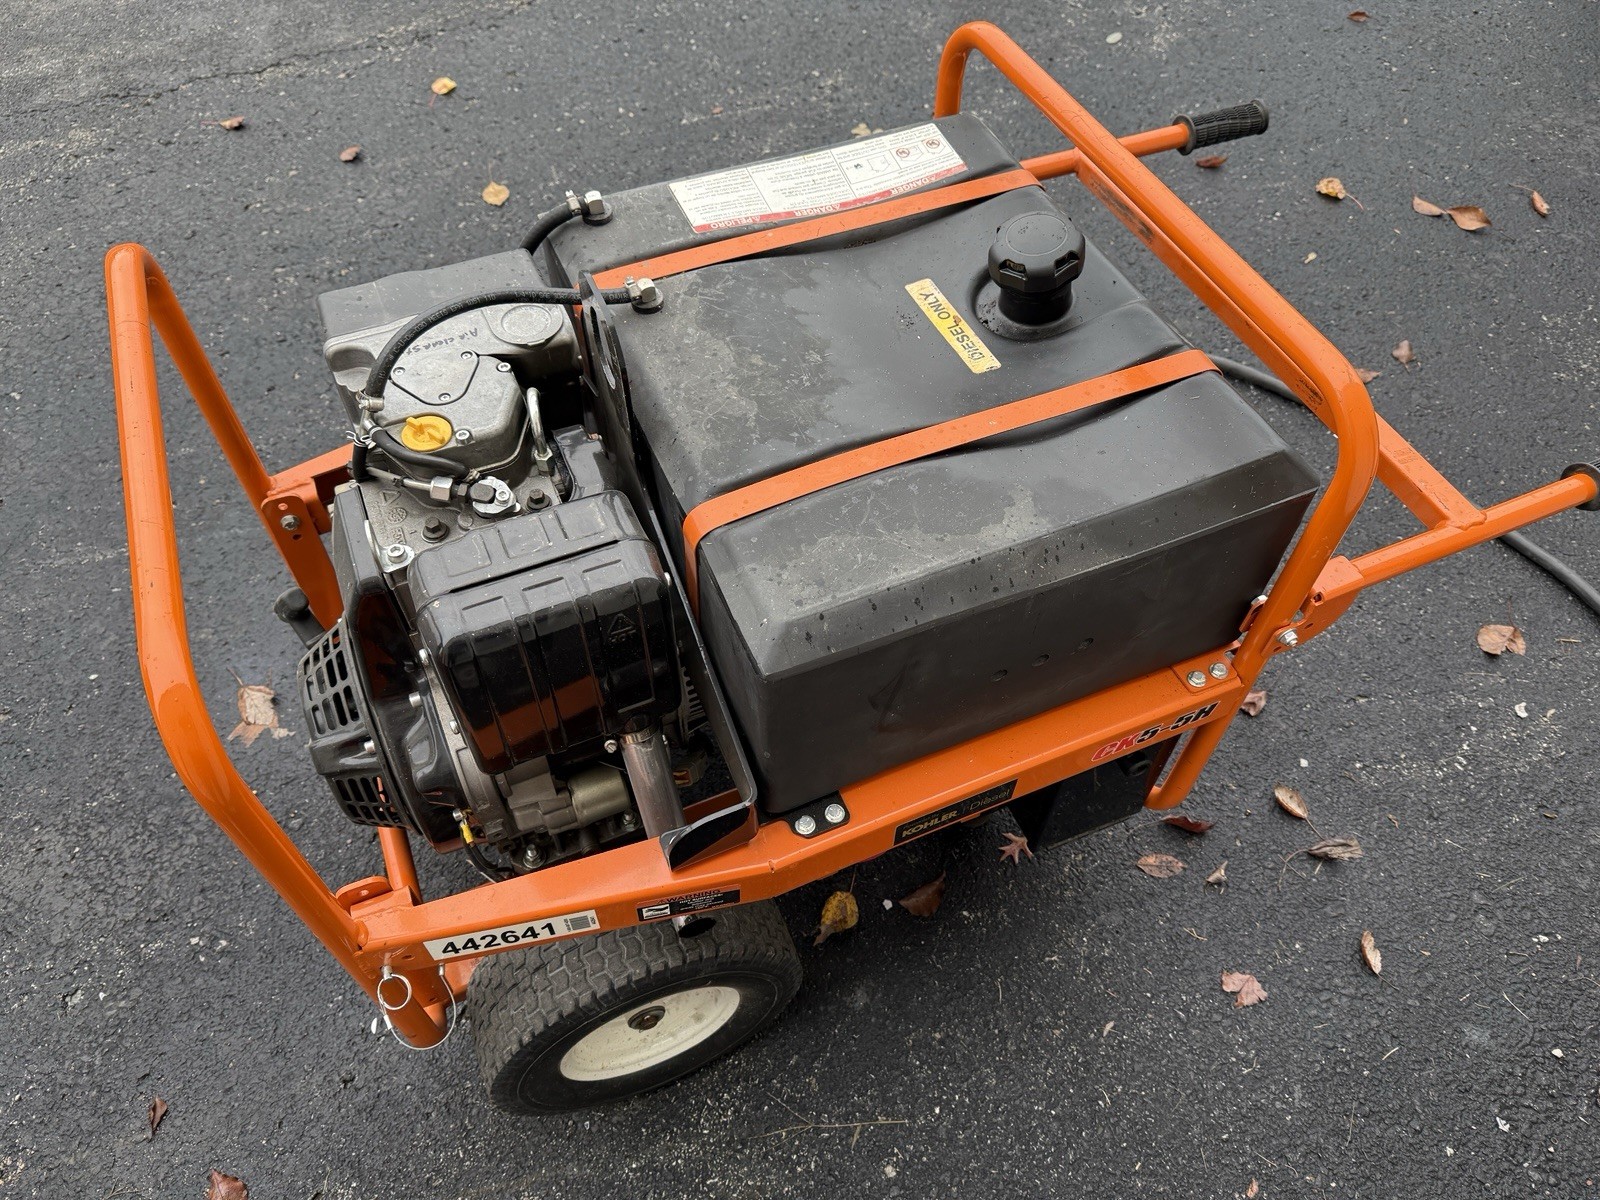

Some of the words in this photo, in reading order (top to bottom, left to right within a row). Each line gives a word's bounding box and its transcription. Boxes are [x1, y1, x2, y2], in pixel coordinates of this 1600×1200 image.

[889, 176, 930, 195] DANGER
[710, 216, 753, 229] PELIGRO
[793, 204, 834, 216] DANGER
[919, 292, 951, 320] ONLY
[947, 321, 985, 361] DIESEL
[1091, 700, 1221, 762] CK5-5H
[902, 810, 958, 838] KOHLER
[666, 889, 721, 902] WARNING
[441, 922, 558, 956] 442641
